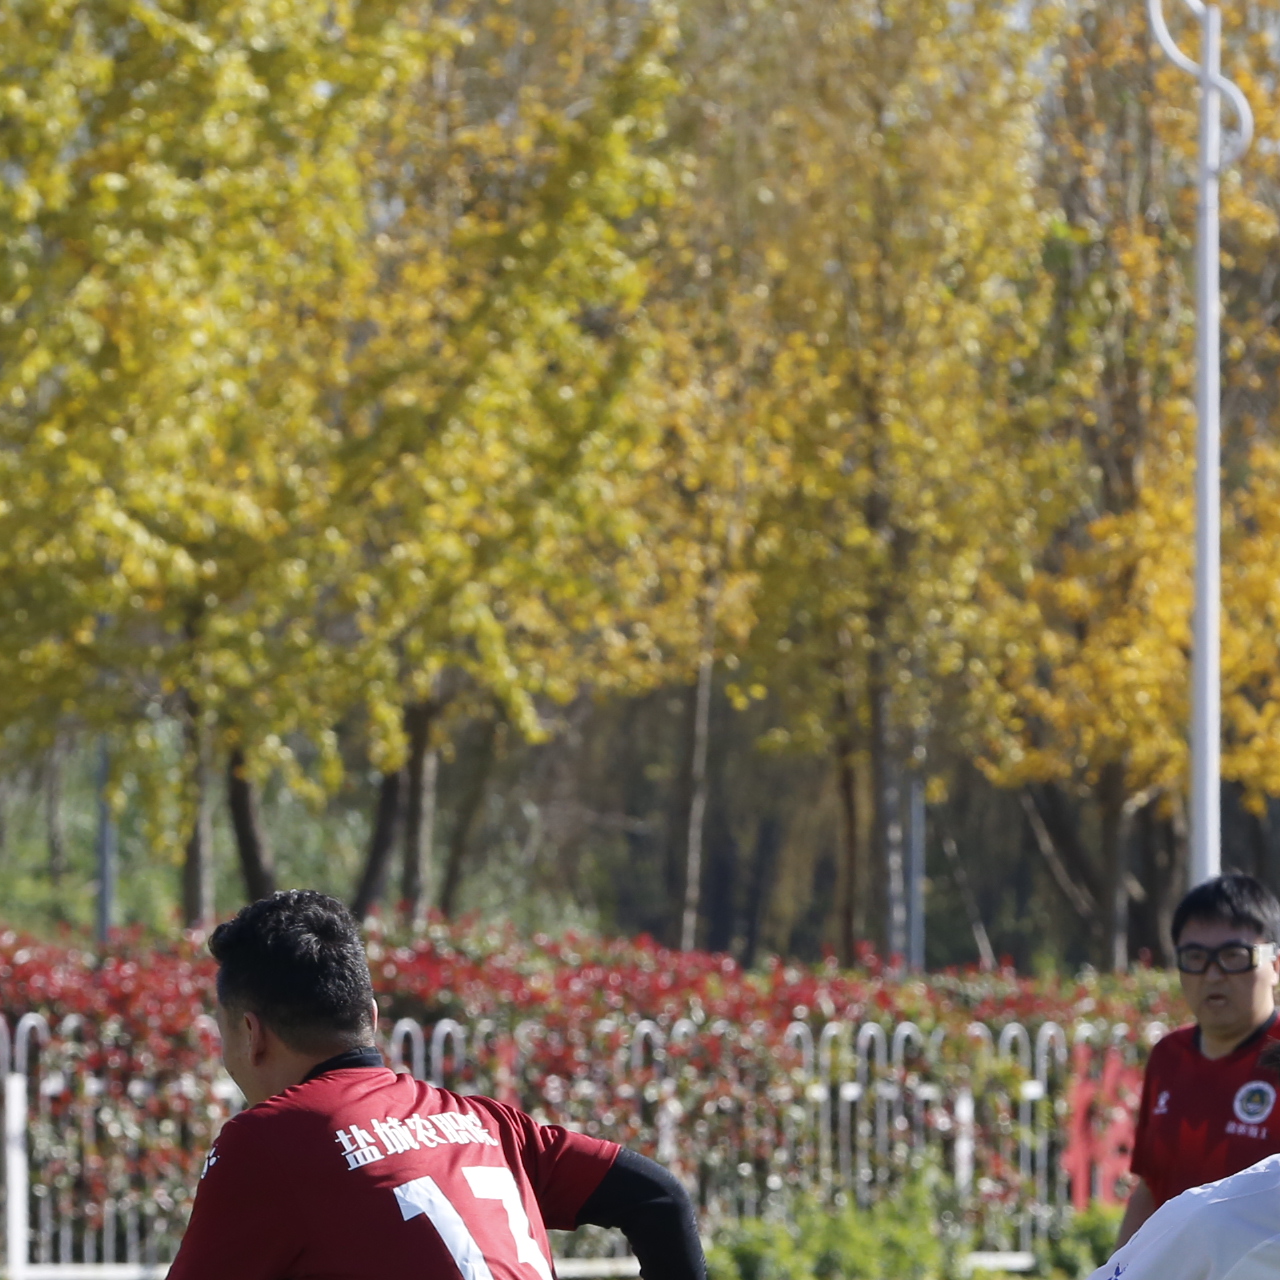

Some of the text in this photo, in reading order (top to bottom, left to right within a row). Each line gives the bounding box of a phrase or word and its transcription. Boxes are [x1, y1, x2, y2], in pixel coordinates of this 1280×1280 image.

[334, 1110, 500, 1171] 盐城农职院
